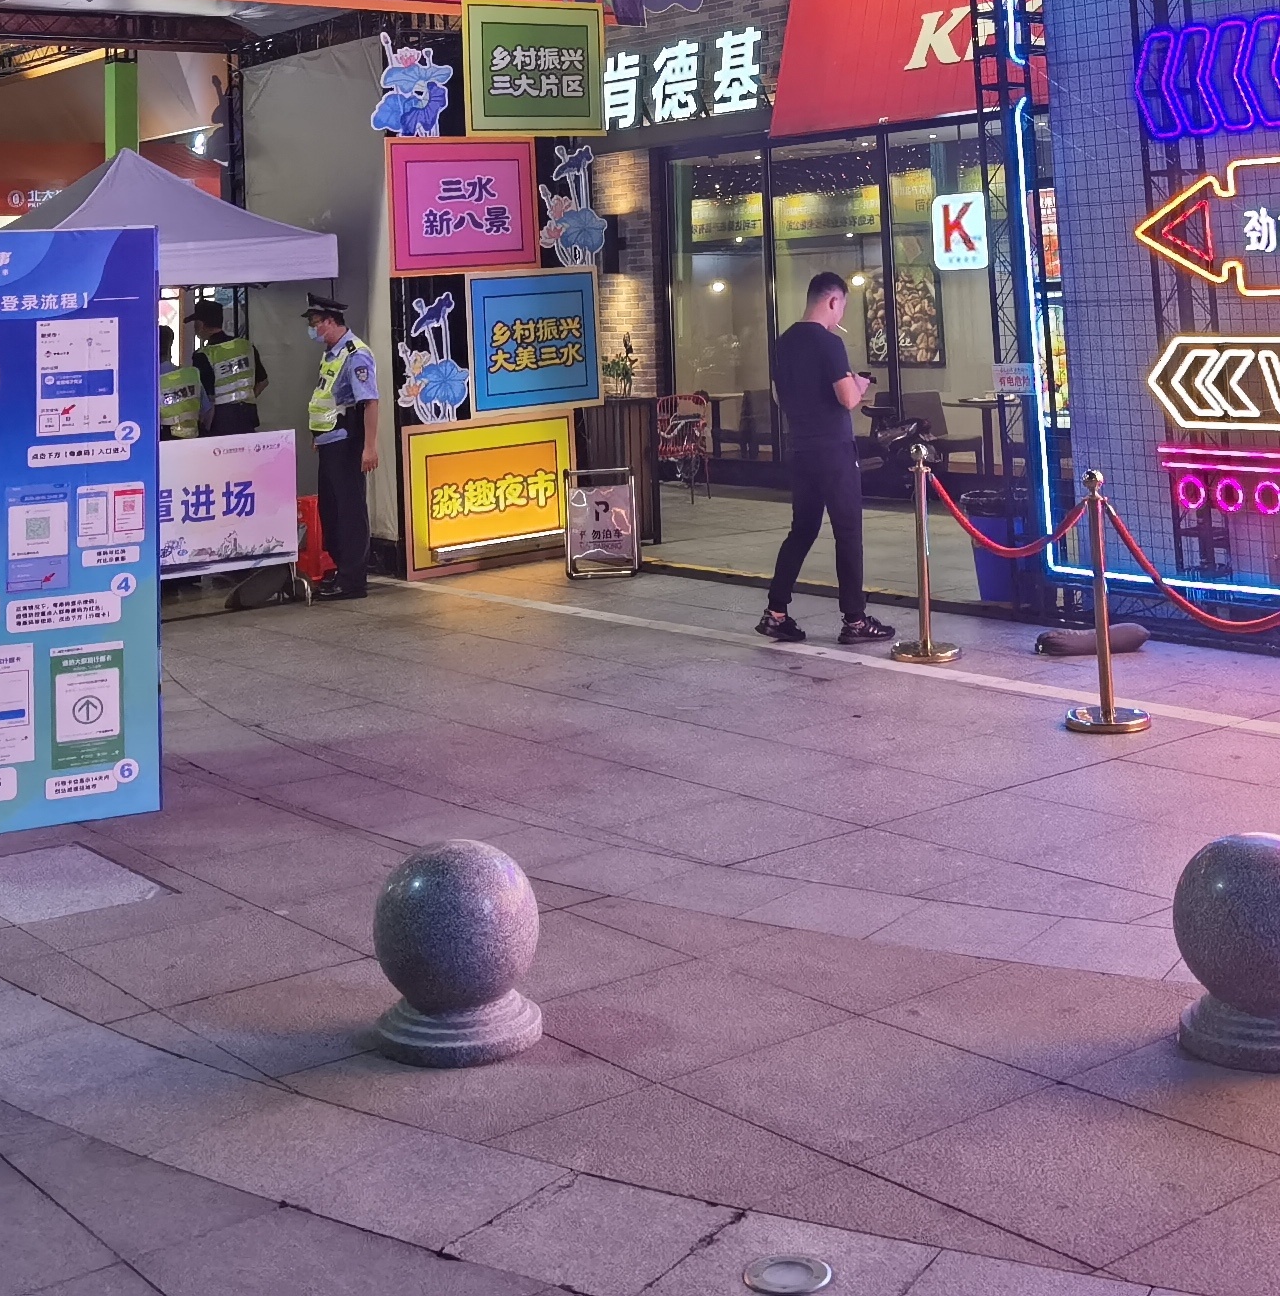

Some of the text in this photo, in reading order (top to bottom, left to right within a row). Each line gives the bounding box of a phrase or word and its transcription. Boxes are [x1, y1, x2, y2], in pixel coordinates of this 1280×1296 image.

[489, 45, 584, 72] 乡村振兴
[488, 73, 584, 97] 三大片区
[604, 26, 762, 130] 肯德基
[27, 189, 62, 201] 北大
[436, 175, 498, 203] 三水
[422, 205, 512, 237] 新八景
[942, 201, 977, 253] K
[491, 316, 582, 347] 乡村振兴
[489, 342, 584, 373] 大美三水
[121, 425, 134, 441] 2
[431, 468, 557, 520] 淼趣夜市
[116, 576, 131, 593] 4
[120, 762, 133, 779] 6
